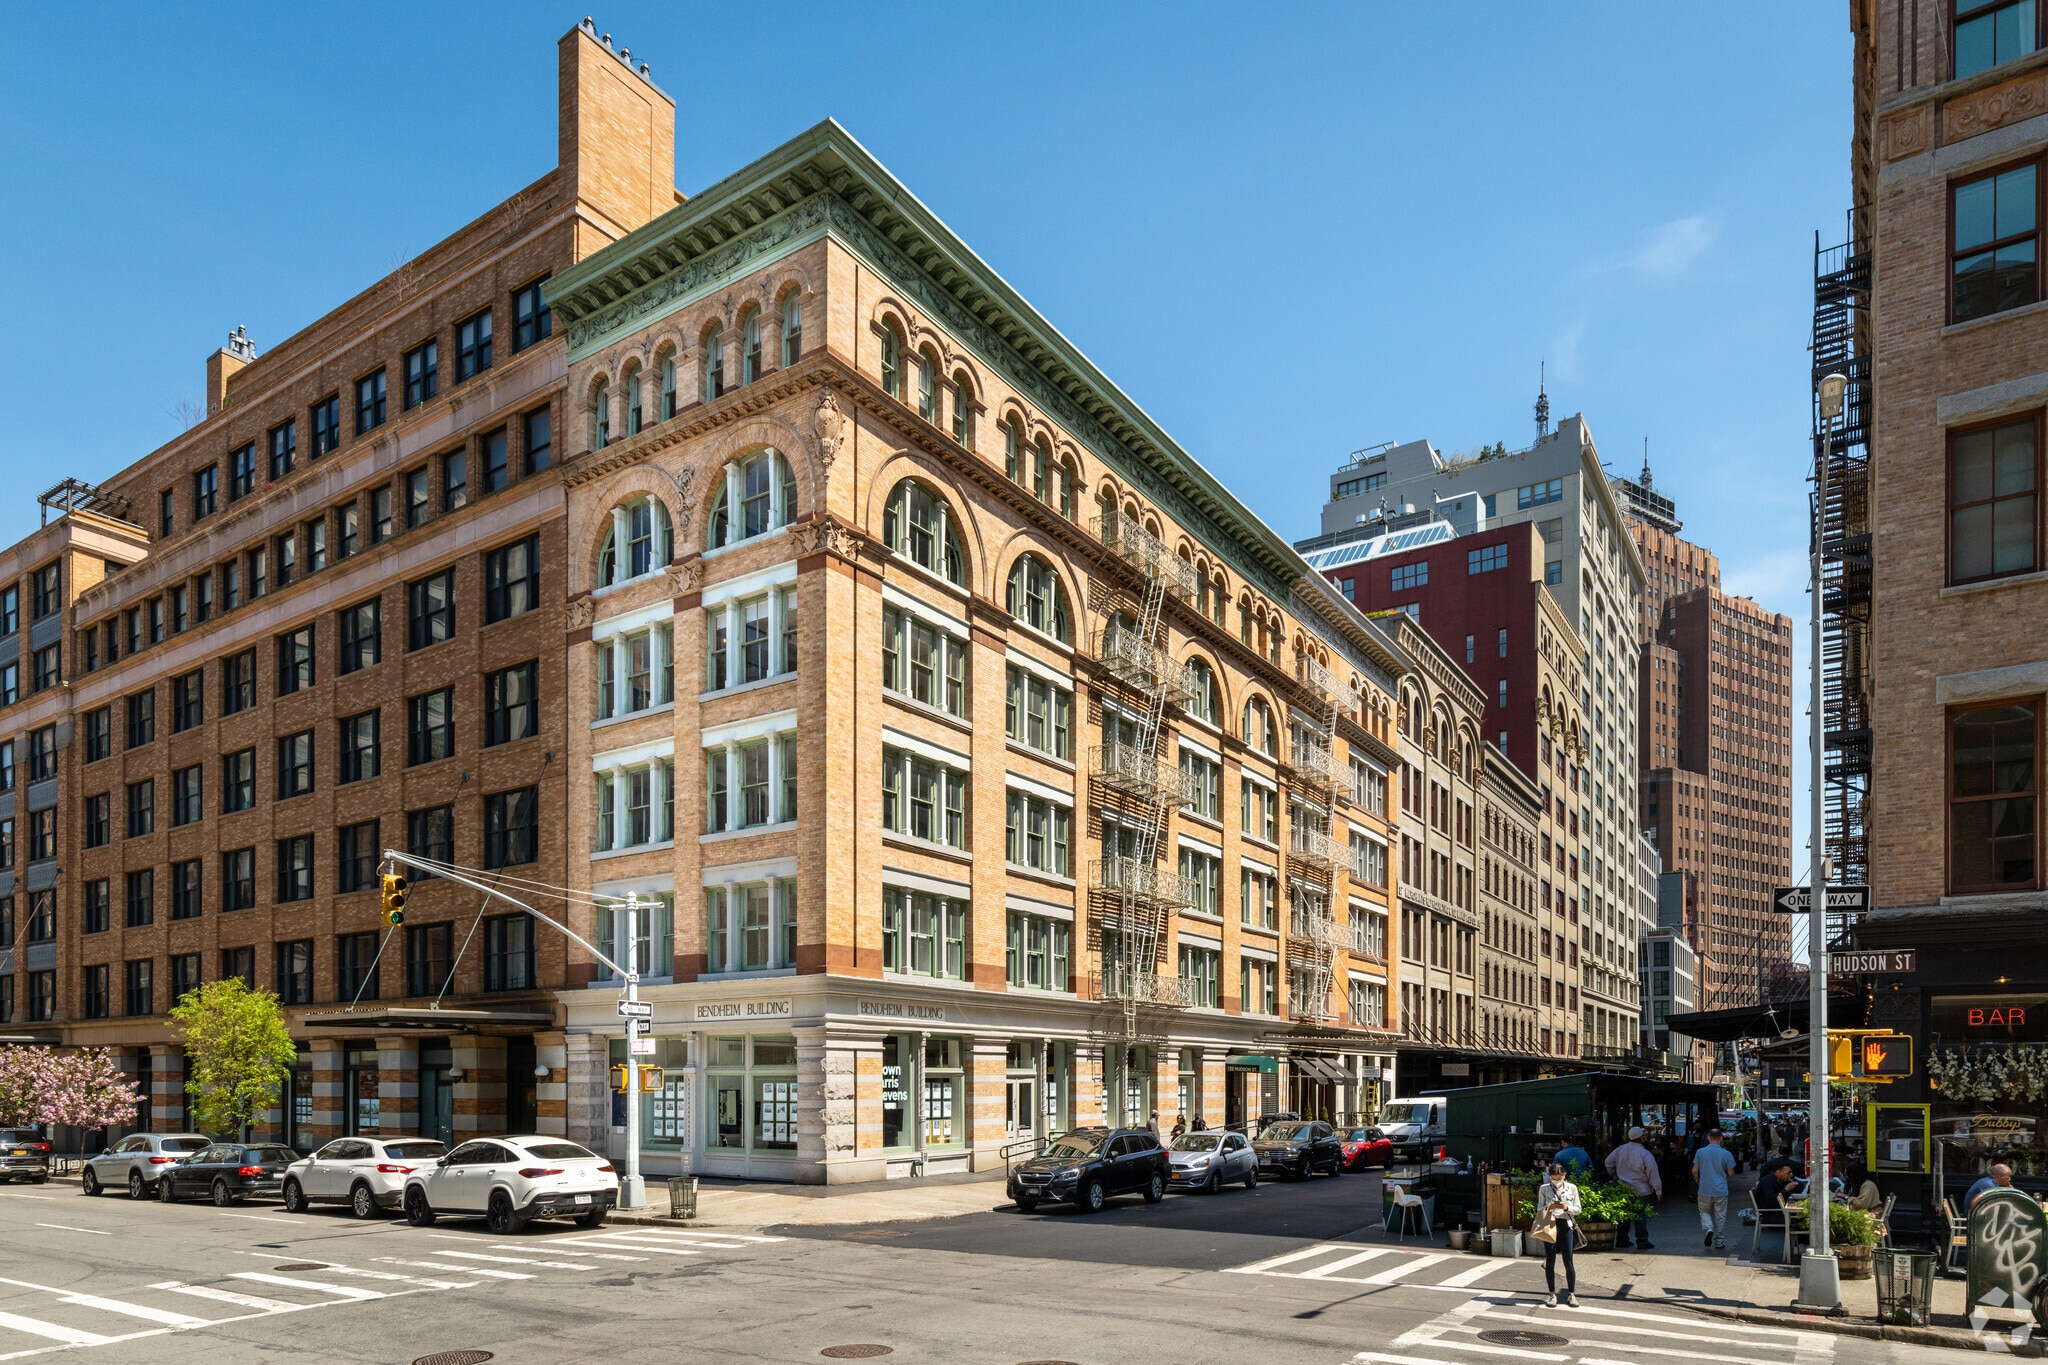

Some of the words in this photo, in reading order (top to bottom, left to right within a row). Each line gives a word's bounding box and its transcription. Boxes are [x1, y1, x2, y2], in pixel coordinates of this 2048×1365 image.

[1827, 894, 1857, 906] WAY
[1833, 954, 1887, 972] HUDSON
[1895, 953, 1911, 970] ST
[623, 1004, 633, 1013] ONE
[697, 1003, 741, 1018] BENDHEIM
[747, 1001, 789, 1016] BUILDING
[861, 1002, 902, 1016] BENDHEIM
[908, 1005, 943, 1018] BUILDING
[1969, 1007, 2025, 1026] BAR
[882, 1090, 908, 1101] evens
